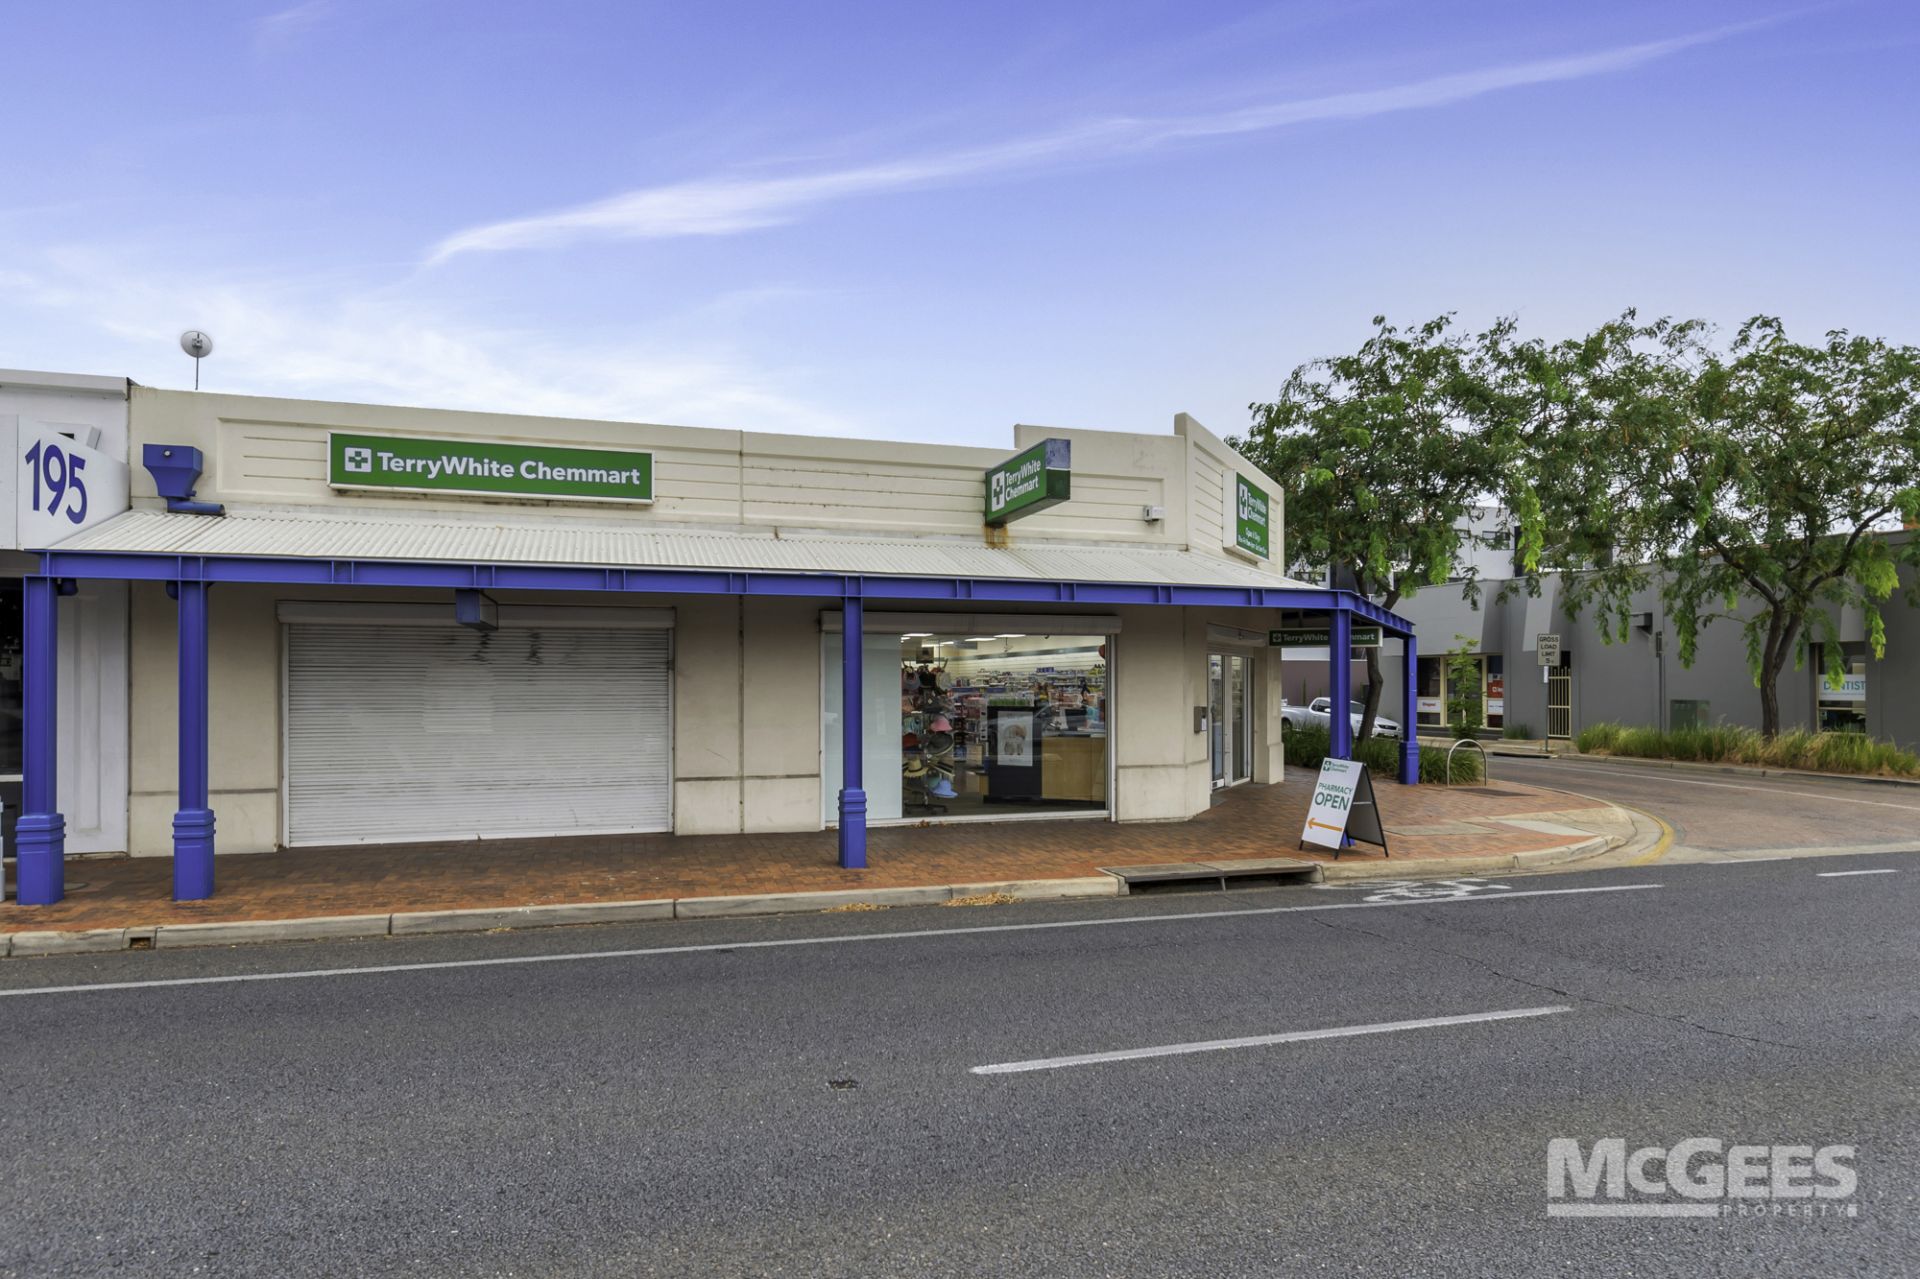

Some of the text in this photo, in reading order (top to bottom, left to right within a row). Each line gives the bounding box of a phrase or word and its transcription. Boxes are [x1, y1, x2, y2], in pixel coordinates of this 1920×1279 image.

[377, 451, 640, 485] TerryWhite Chemmart
[1005, 459, 1042, 486] TerryWhite
[24, 439, 88, 525] 195
[1005, 475, 1039, 502] Chemmart
[1283, 634, 1329, 643] TerryWhite
[1823, 680, 1866, 690] DNTIST
[1318, 782, 1353, 796] PHARMACY
[1314, 792, 1350, 811] OPEN
